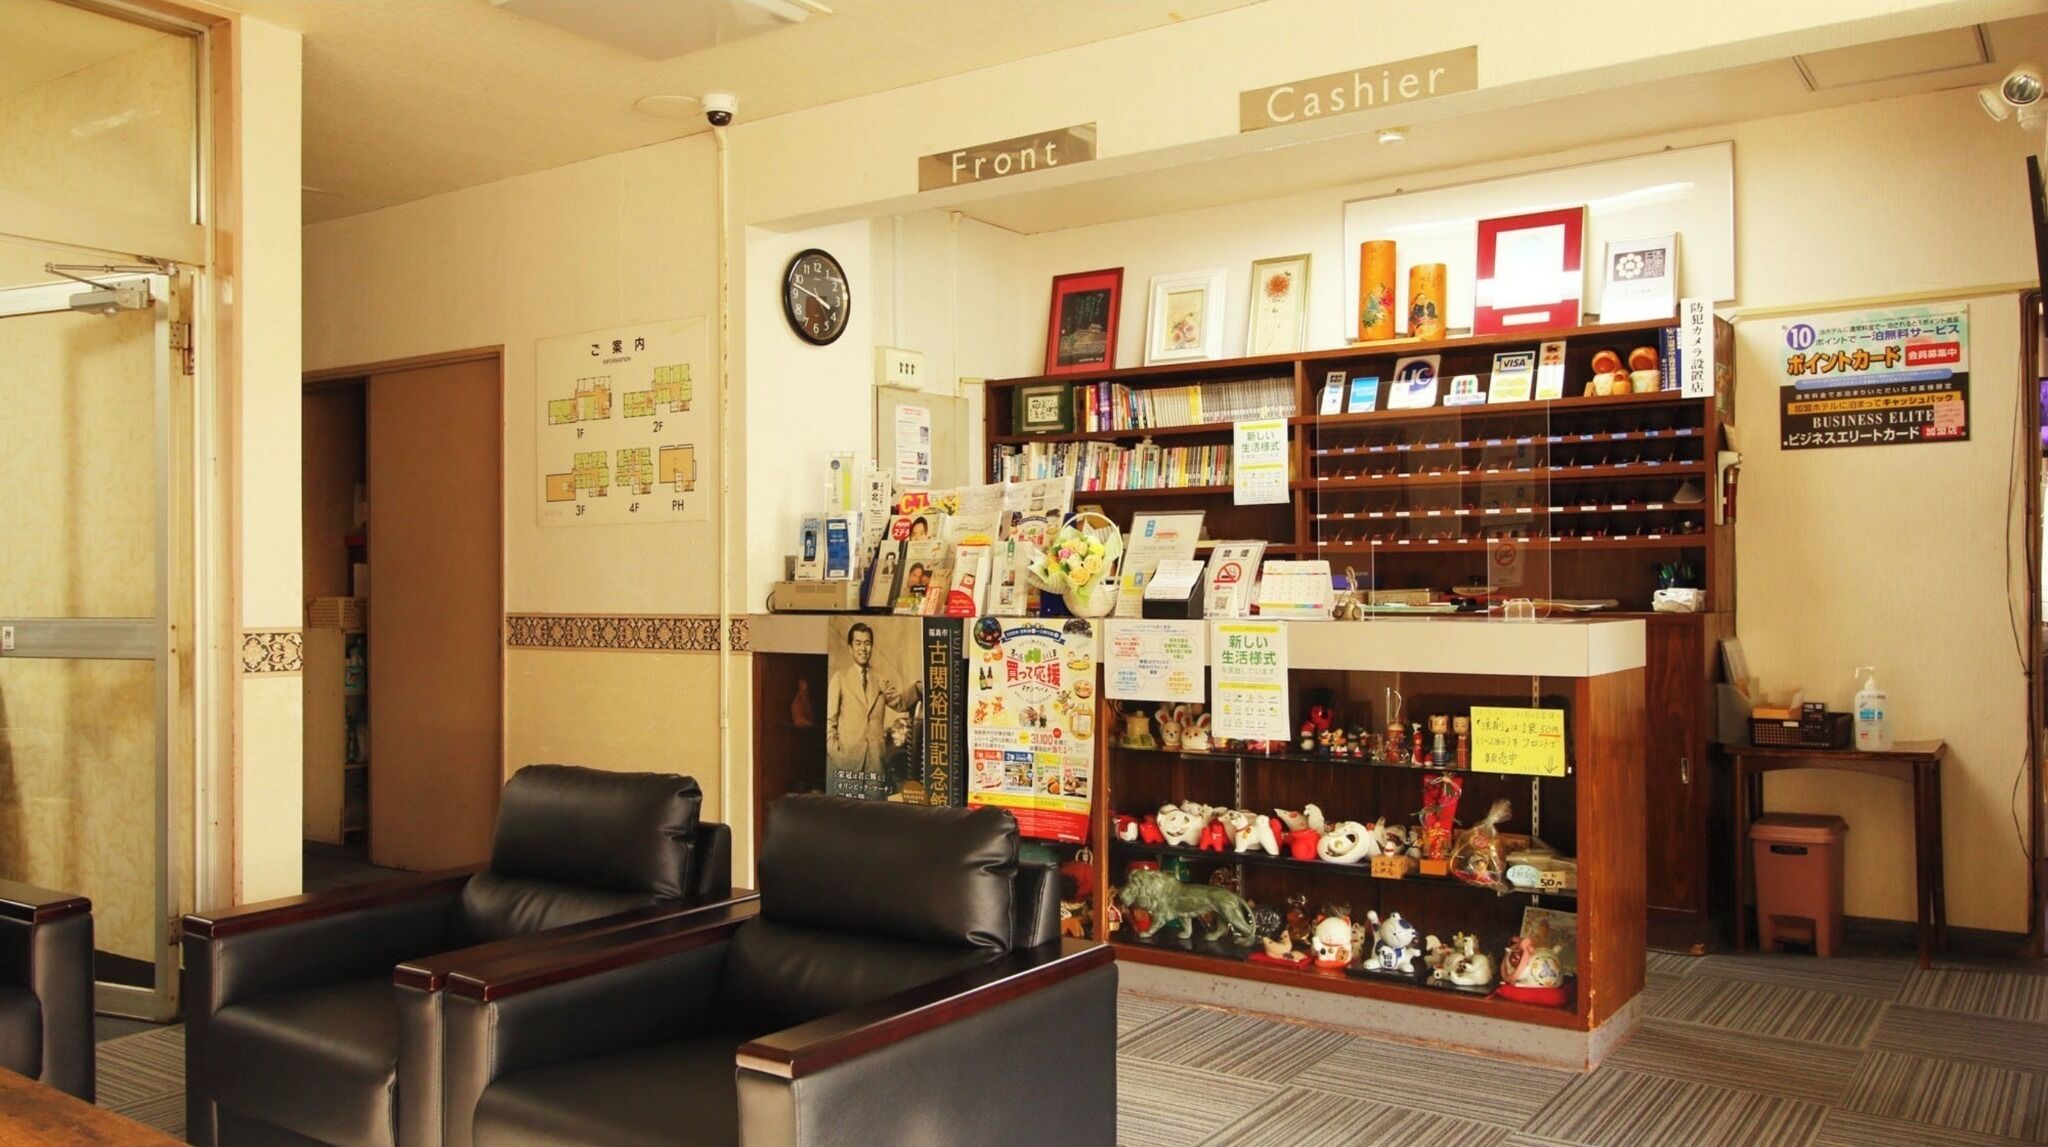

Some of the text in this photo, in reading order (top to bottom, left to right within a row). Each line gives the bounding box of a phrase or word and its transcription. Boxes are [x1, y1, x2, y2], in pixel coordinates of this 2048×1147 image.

[1266, 66, 1447, 123] Cashier
[951, 139, 1057, 184] Front
[803, 264, 810, 274] 11
[813, 262, 822, 273] 12
[795, 274, 803, 284] 10
[825, 270, 830, 278] 1
[832, 281, 838, 292] 2
[792, 288, 799, 299] 9
[834, 296, 840, 307] 3
[795, 304, 802, 315] 8
[803, 316, 809, 327] 7
[830, 312, 837, 322] 4
[813, 323, 819, 334] 6
[823, 320, 830, 331] 5
[1790, 327, 1812, 348] 10
[1690, 302, 1704, 393] 防犯カメラ設置店
[1503, 358, 1526, 368] VISA
[1787, 345, 1901, 376] ポイントカード
[1813, 412, 1883, 429] BUSINESS
[1889, 409, 1935, 424] ELITE
[653, 421, 663, 433] 2F
[576, 428, 584, 438] 1F
[1247, 431, 1274, 441] 新しい
[1788, 426, 1920, 447] ビジネスエリートカード
[1241, 441, 1280, 453] 生活様式
[575, 505, 586, 516] 3F
[629, 503, 640, 513] 4F
[672, 500, 684, 511] PH
[1228, 634, 1269, 649] 新しい
[1221, 650, 1277, 666] 生活様式
[1006, 660, 1060, 688] 買って応援
[928, 640, 949, 807] 古関裕而記念館
